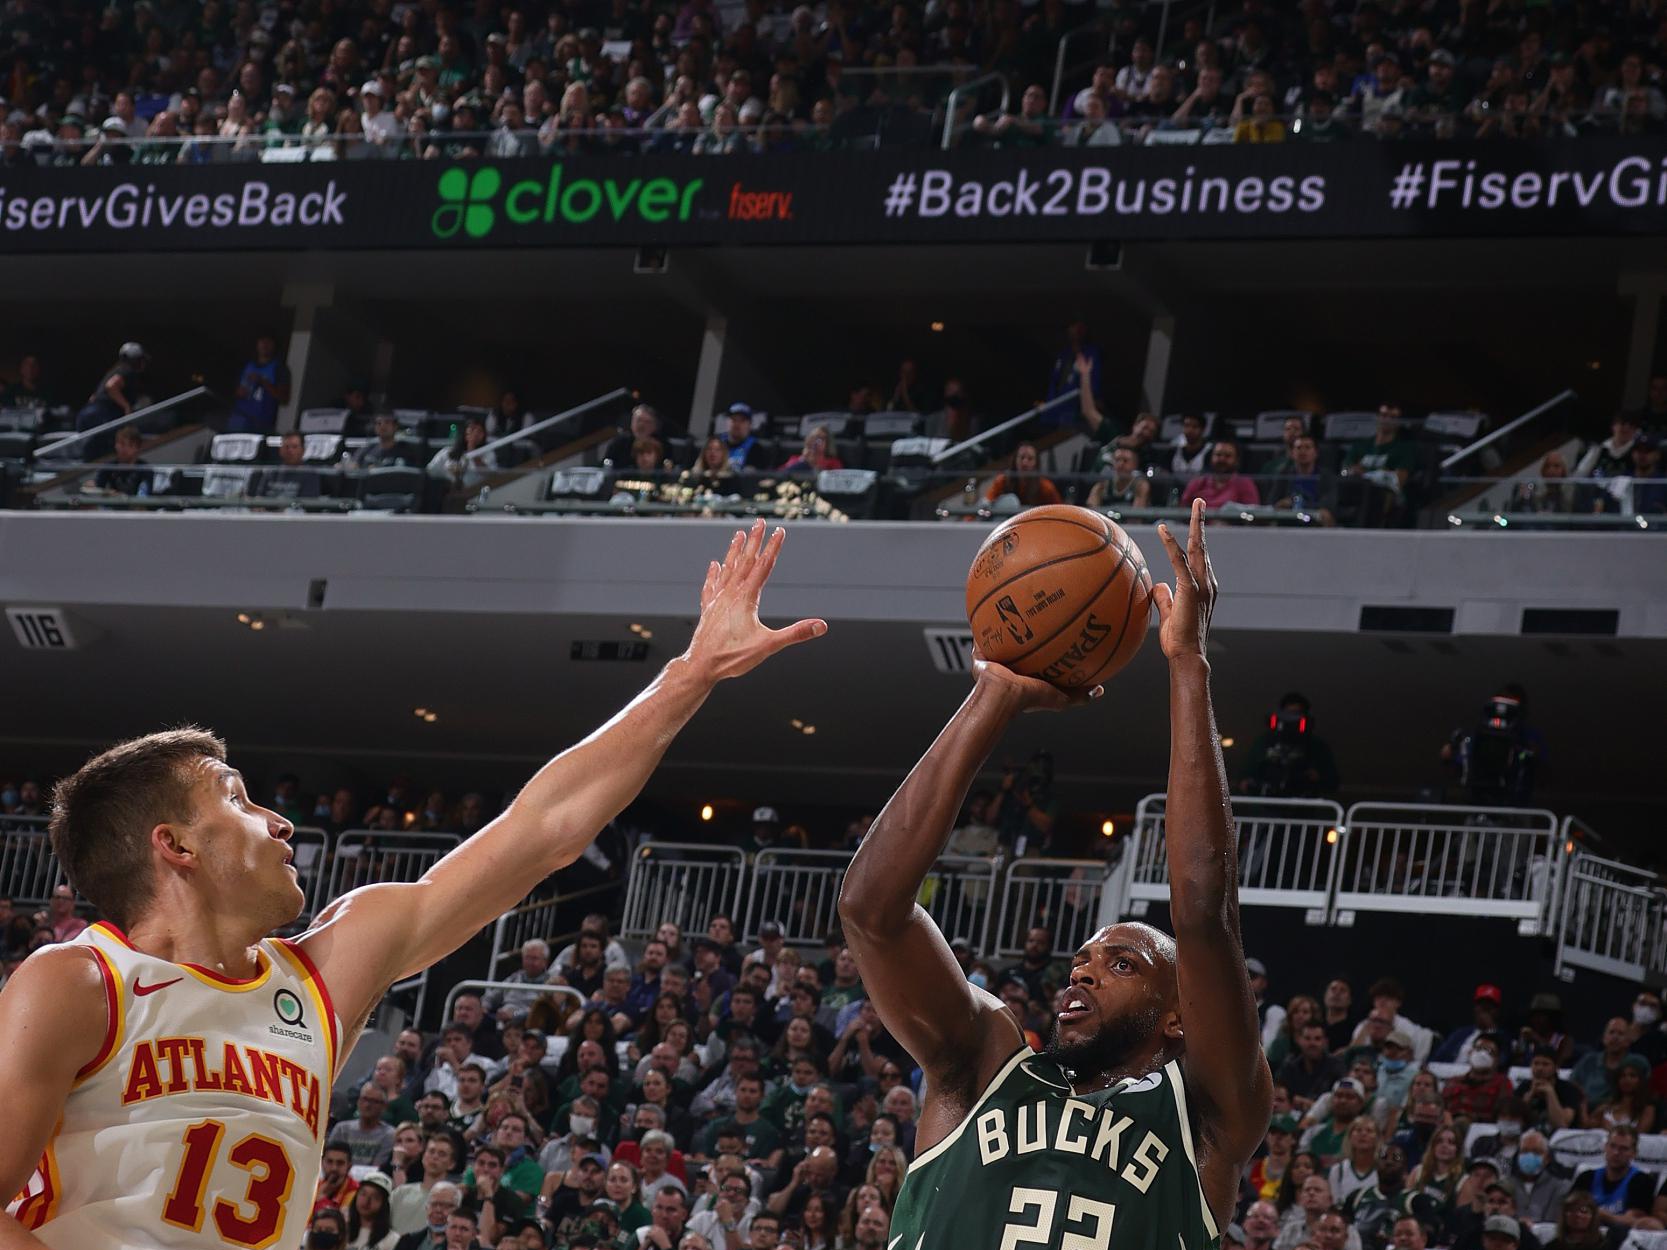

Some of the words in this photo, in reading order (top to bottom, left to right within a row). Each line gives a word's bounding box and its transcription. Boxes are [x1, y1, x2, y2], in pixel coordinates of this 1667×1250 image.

[504, 163, 703, 224] clover
[884, 166, 1326, 218] #Back2Business
[15, 614, 65, 647] 116
[1042, 612, 1112, 680] SPALD
[269, 1025, 312, 1043] sharecare
[121, 1037, 321, 1143] ATLANTA
[976, 1099, 1170, 1194] BUCKS
